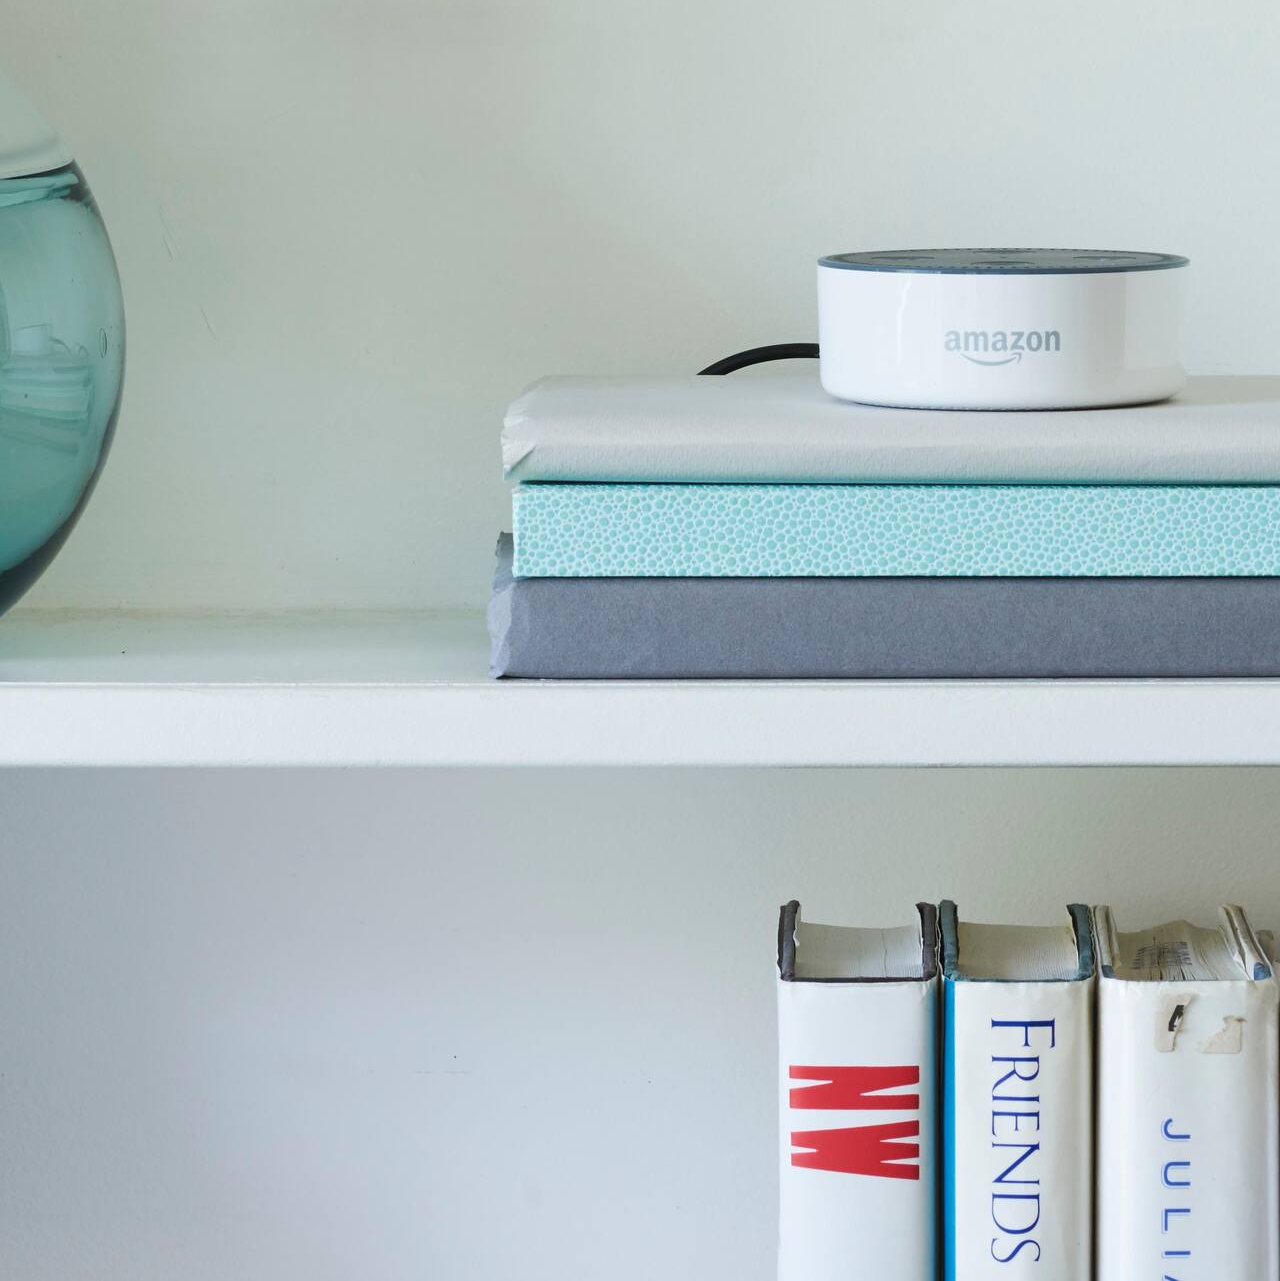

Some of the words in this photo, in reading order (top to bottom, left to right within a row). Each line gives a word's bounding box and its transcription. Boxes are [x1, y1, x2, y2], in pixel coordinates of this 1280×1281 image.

[944, 330, 1061, 352] amazon
[789, 1065, 920, 1180] NW
[990, 1018, 1055, 1263] FRIENDS
